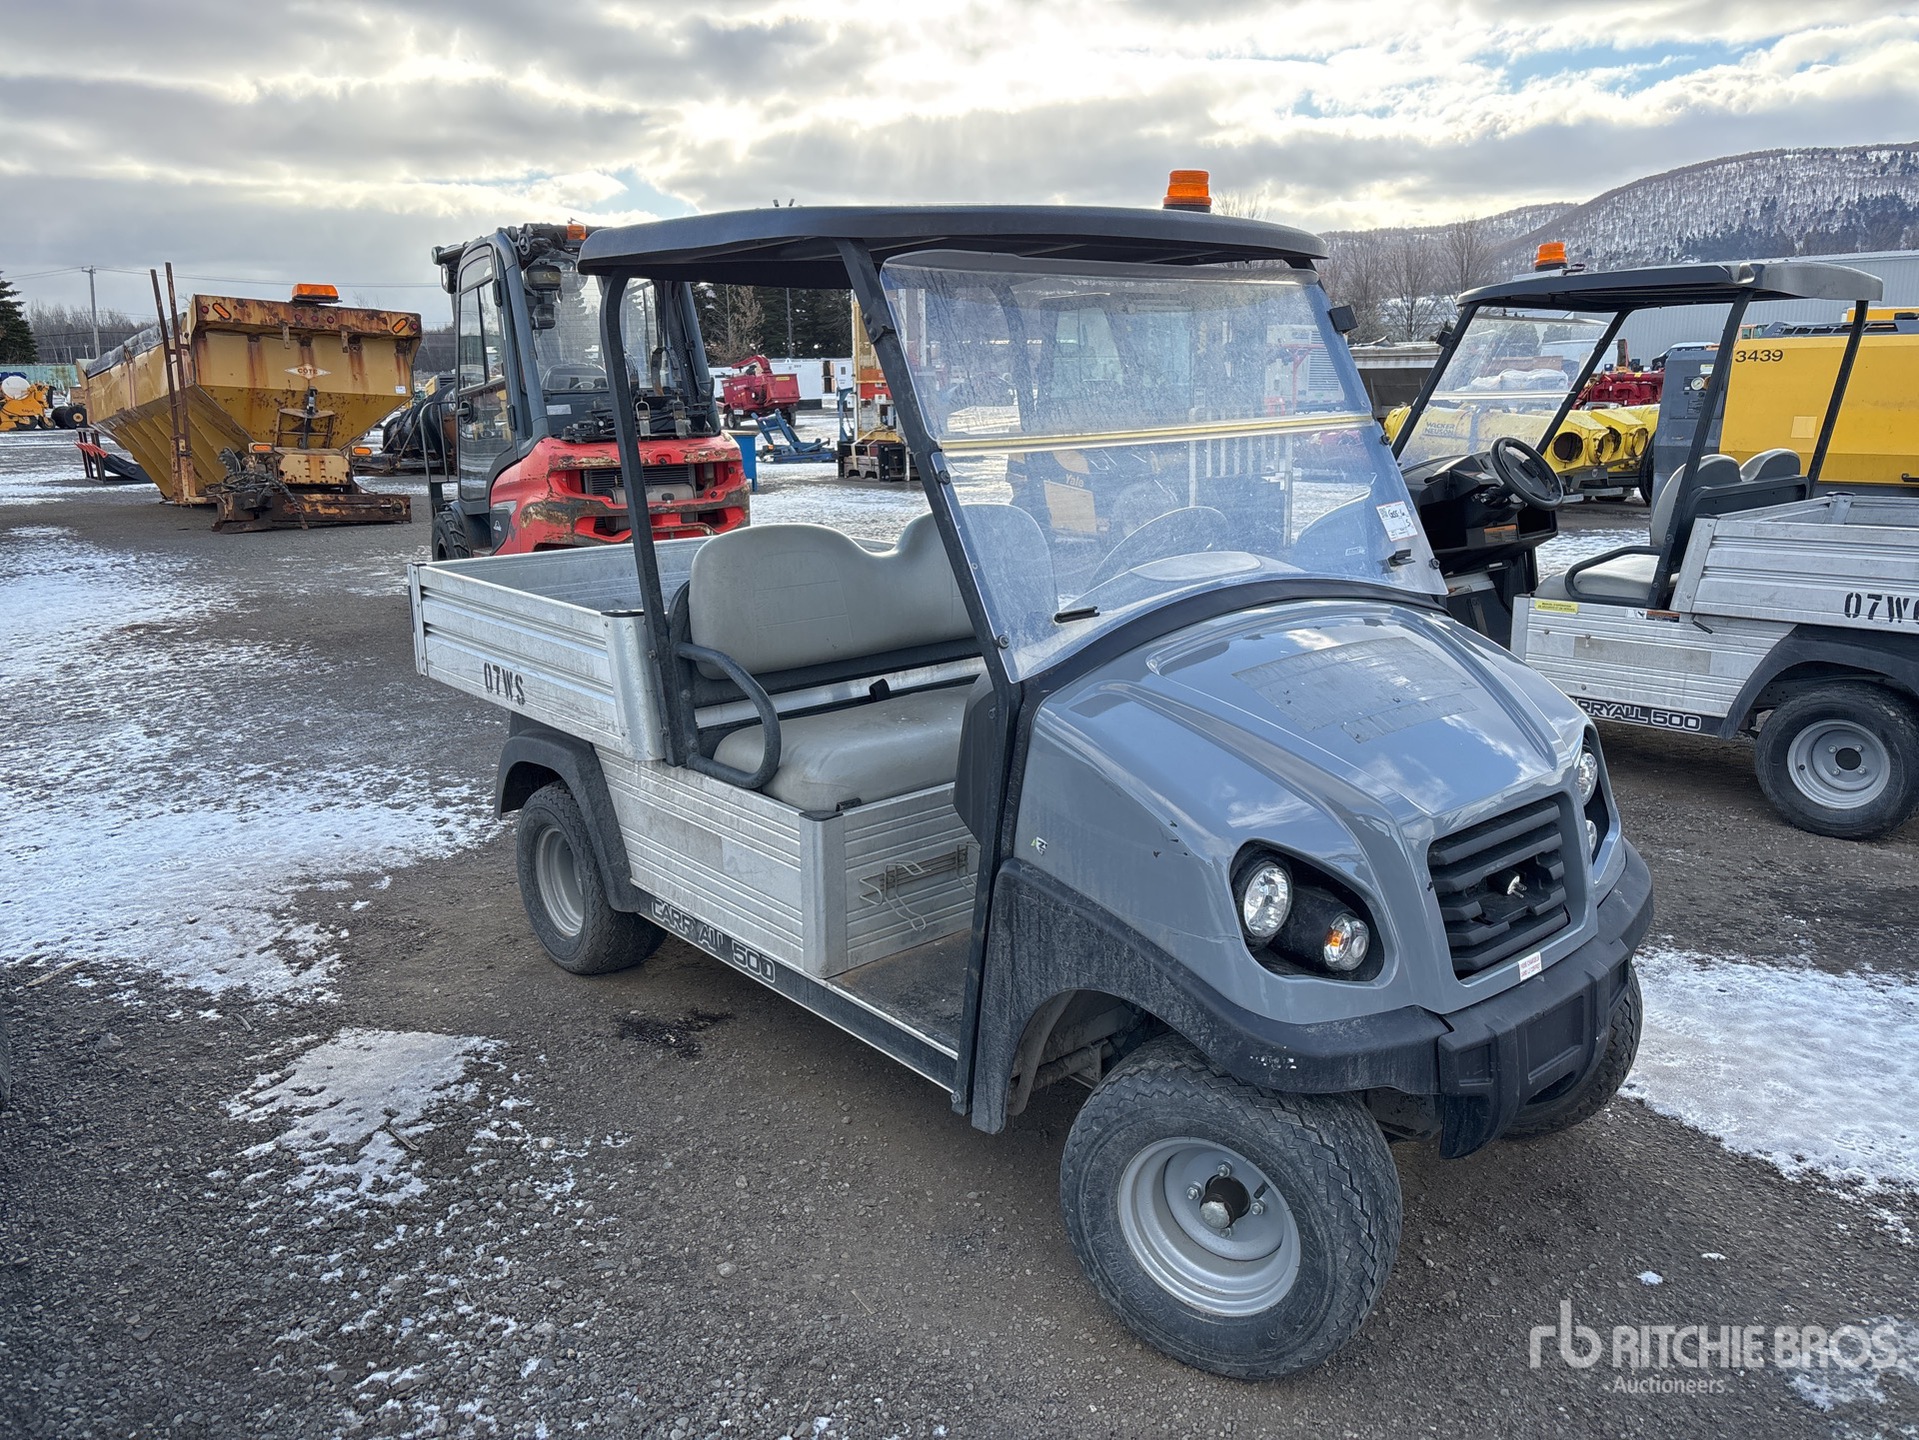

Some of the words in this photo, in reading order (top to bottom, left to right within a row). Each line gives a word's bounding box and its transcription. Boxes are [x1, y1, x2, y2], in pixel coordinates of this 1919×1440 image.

[1735, 349, 1784, 363] 3439
[1065, 473, 1085, 488] Yale
[483, 661, 526, 706] 07WS
[1571, 697, 1649, 724] RRYALL
[1650, 708, 1702, 732] 500
[731, 939, 776, 984] 500
